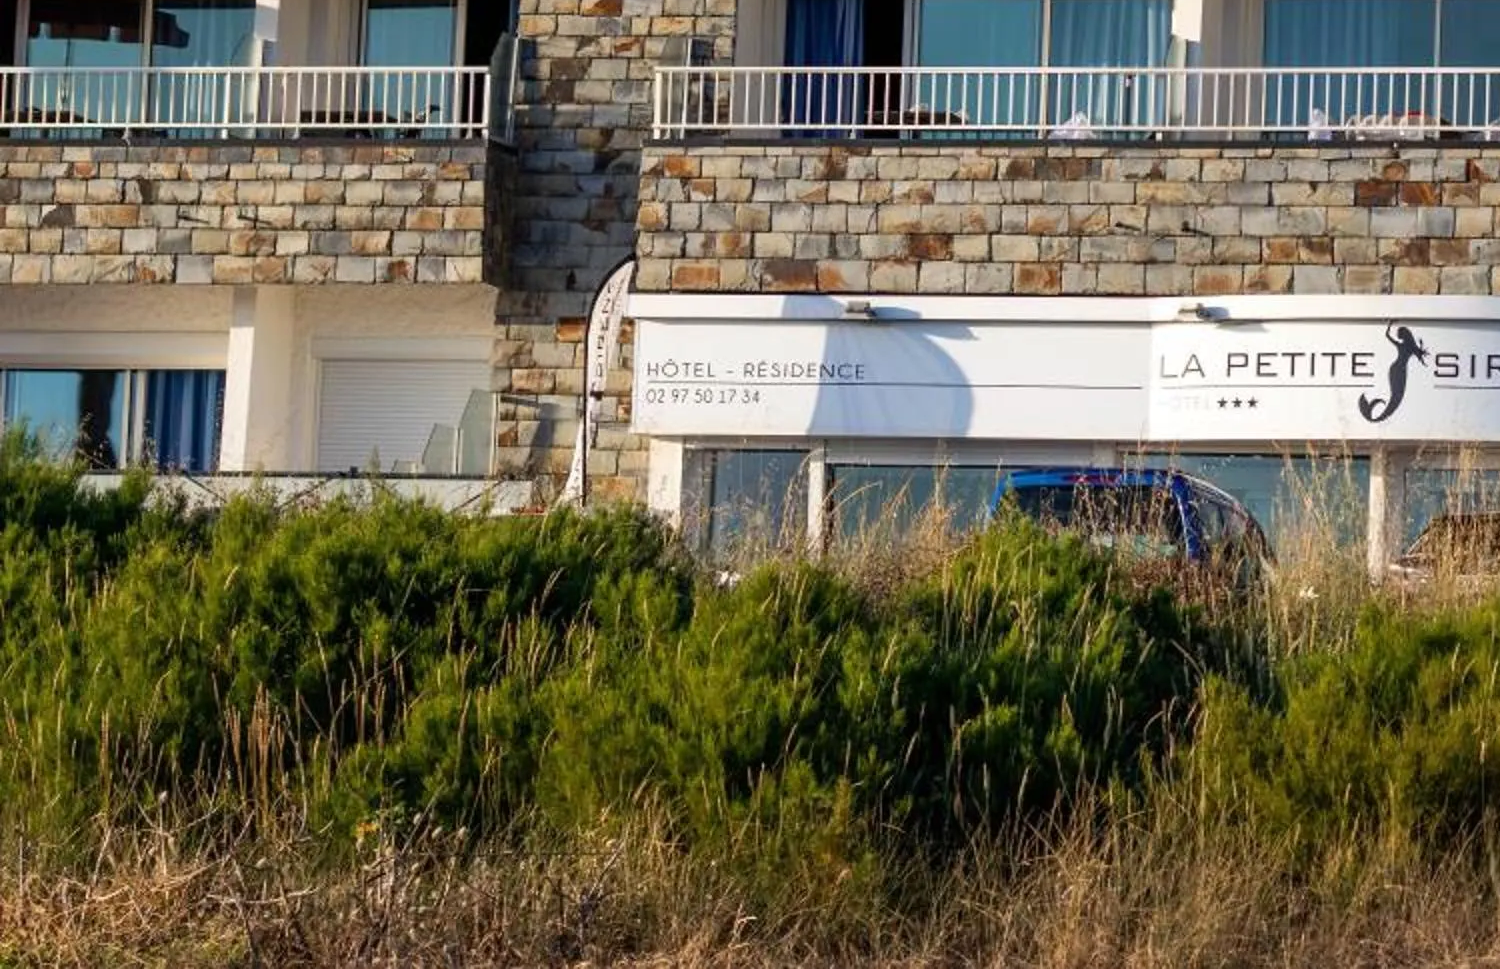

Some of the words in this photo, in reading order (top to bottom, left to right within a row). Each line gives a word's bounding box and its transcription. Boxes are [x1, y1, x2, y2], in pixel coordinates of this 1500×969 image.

[646, 359, 716, 378] HÔTEL
[743, 360, 865, 379] RÉSIDENCE
[1159, 353, 1206, 379] LA
[1225, 351, 1376, 378] PETITE
[645, 388, 665, 404] 02
[671, 388, 689, 404] 97
[694, 388, 713, 404] 50
[718, 388, 737, 404] 17
[741, 389, 760, 404] 34
